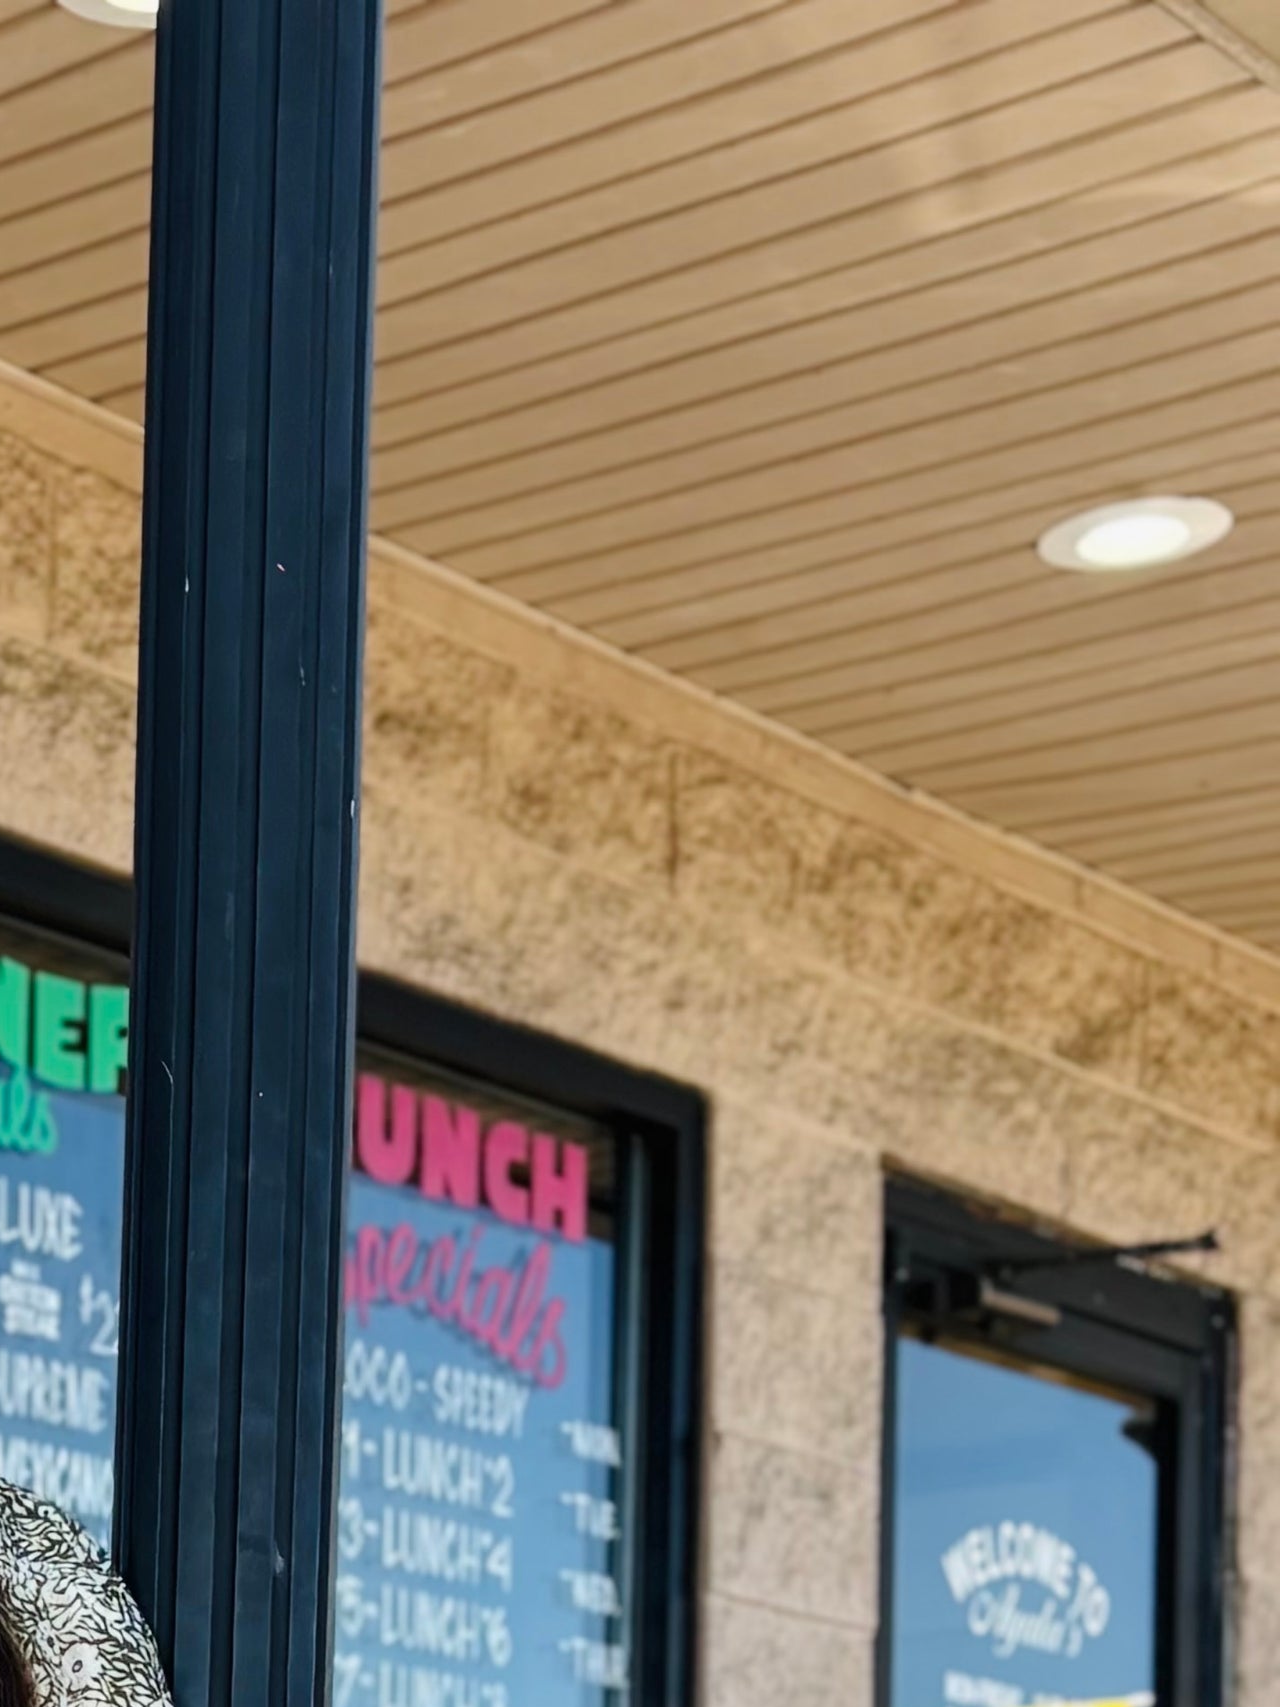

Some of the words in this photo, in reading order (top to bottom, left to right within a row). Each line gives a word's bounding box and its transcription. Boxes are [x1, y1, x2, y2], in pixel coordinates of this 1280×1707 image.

[357, 1073, 588, 1244] UNCH
[342, 1340, 412, 1410] OCO
[344, 1222, 567, 1390] pecials
[941, 1519, 1076, 1603] WELCOME
[1064, 1561, 1111, 1638] TO
